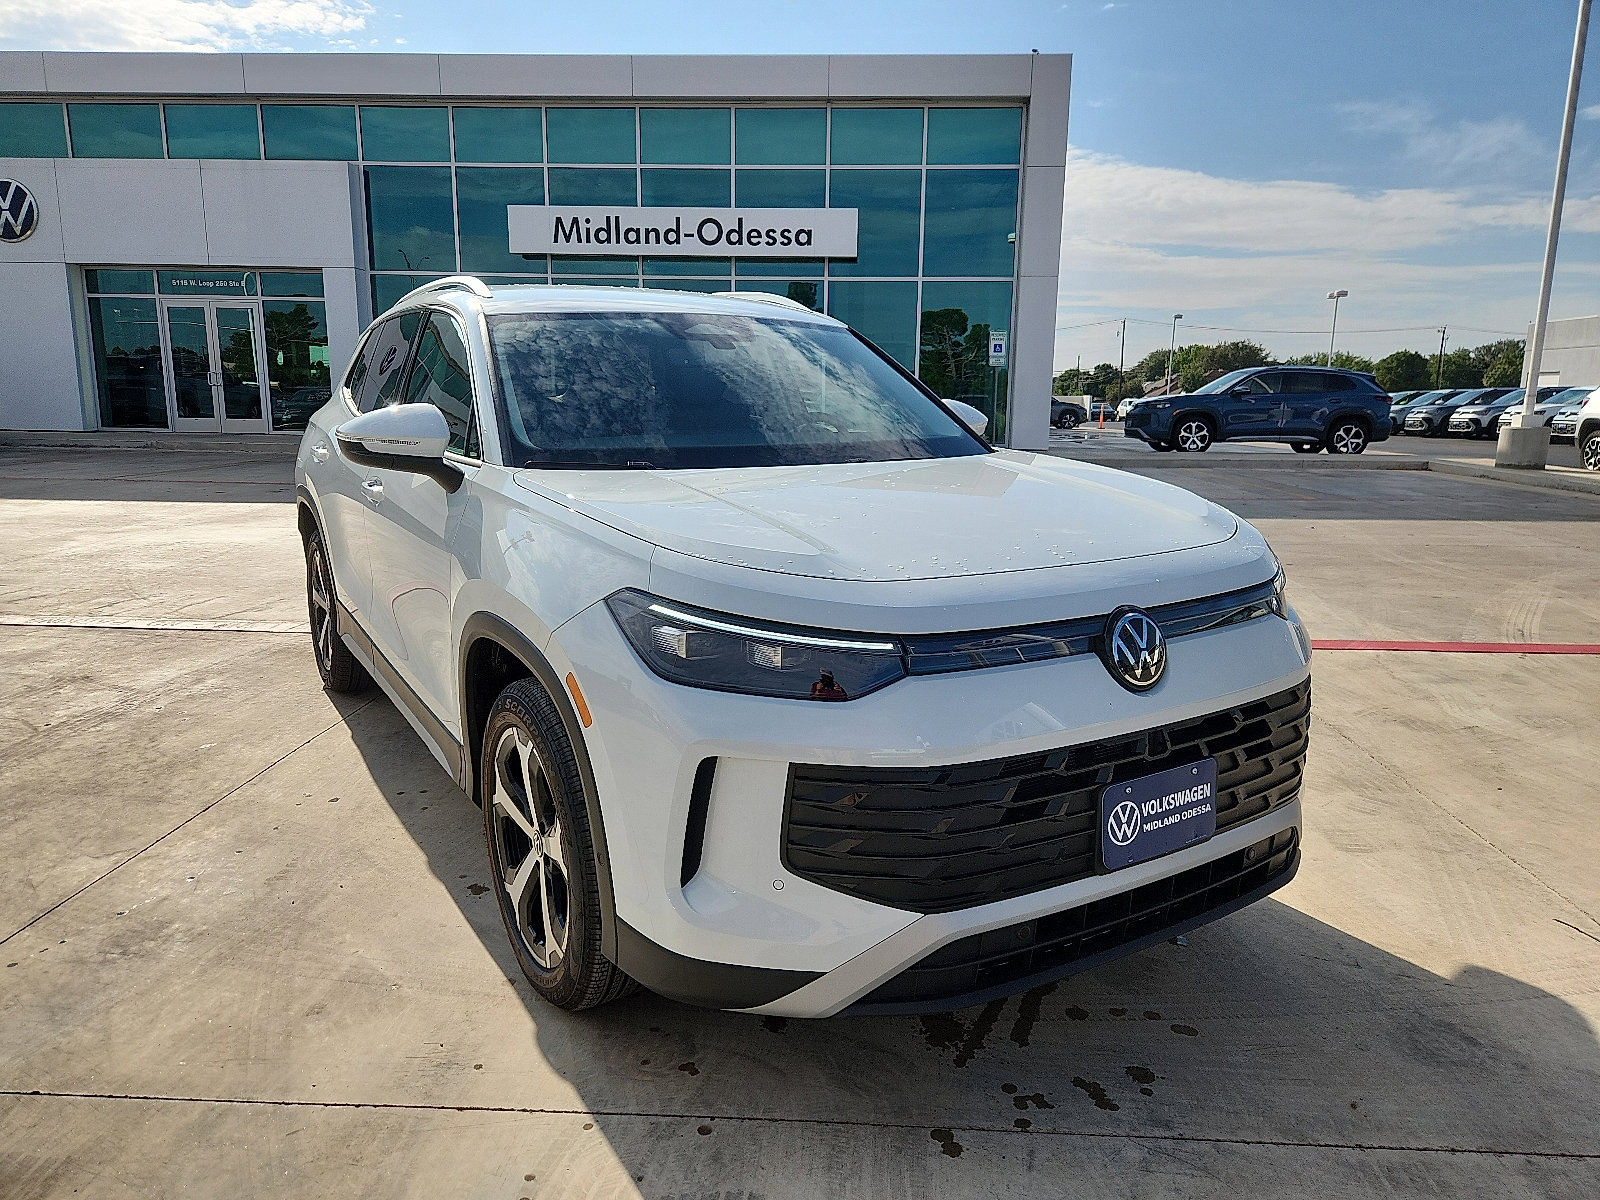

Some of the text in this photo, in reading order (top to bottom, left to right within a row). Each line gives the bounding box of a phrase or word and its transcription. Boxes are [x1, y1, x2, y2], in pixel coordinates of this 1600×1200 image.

[552, 214, 814, 247] Midland-Odessa
[198, 279, 214, 288] Loop
[1141, 782, 1211, 817] VOLKSWAGEN
[1142, 803, 1212, 833] MIDLAND ODESSA
